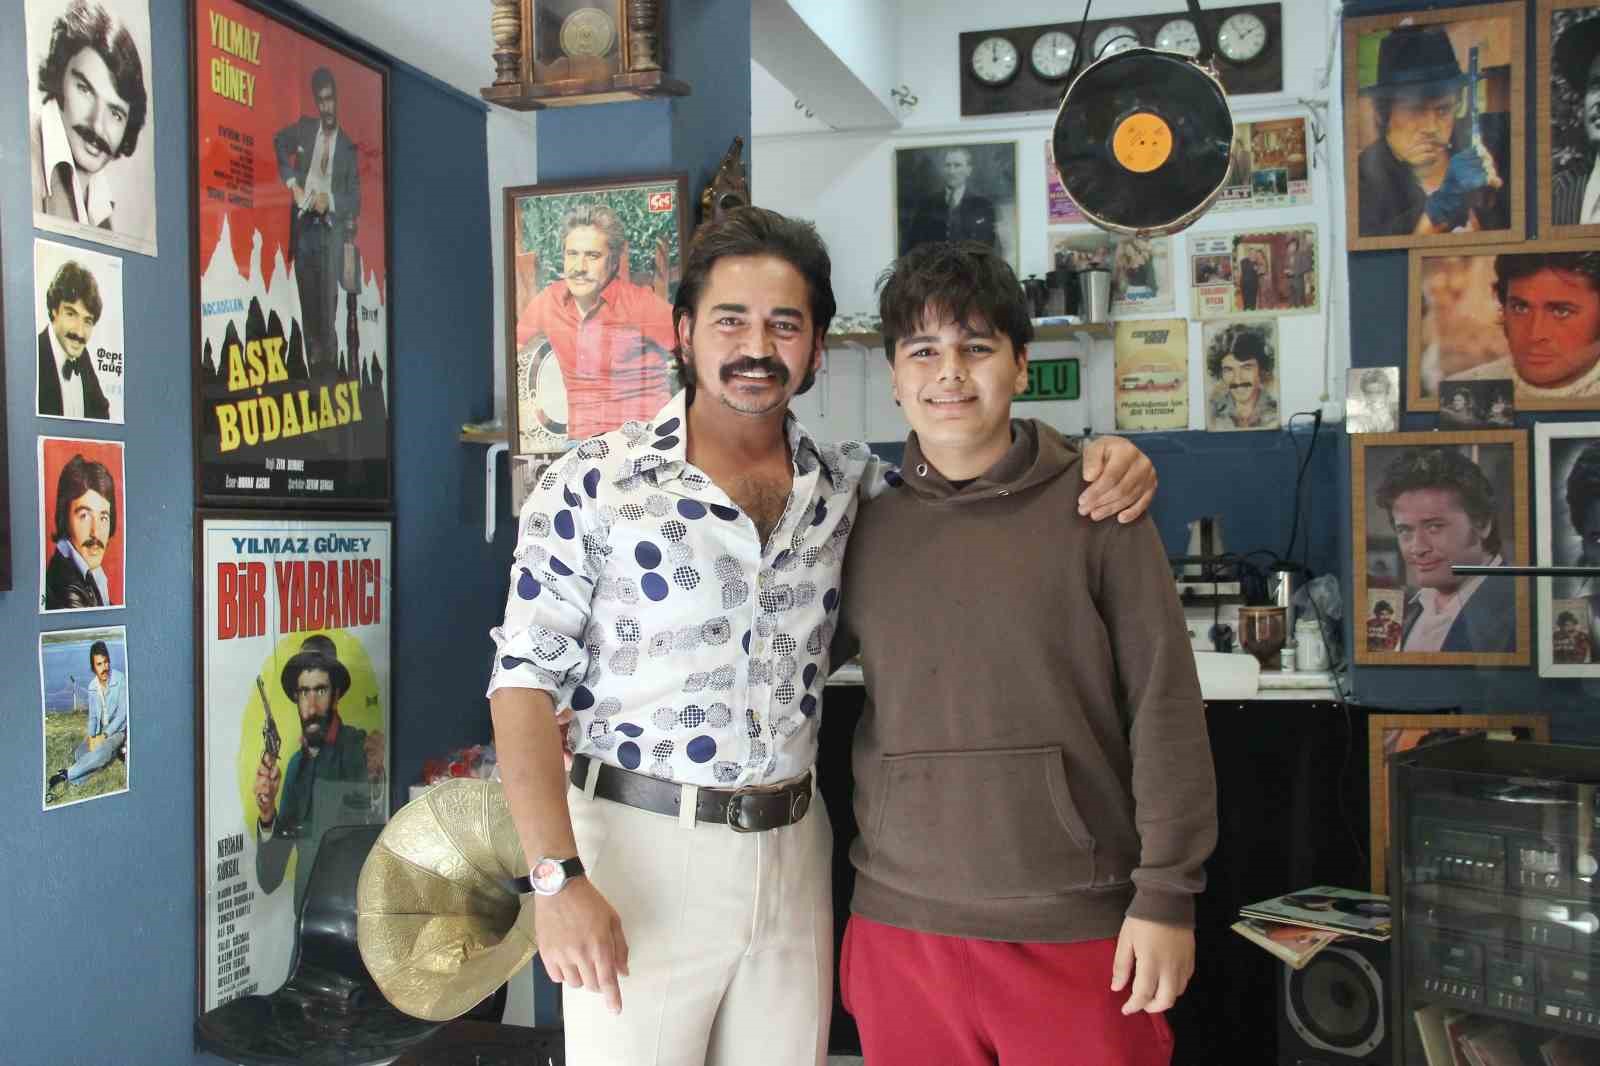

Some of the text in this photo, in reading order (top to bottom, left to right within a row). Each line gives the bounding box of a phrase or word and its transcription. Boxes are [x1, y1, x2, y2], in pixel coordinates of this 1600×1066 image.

[209, 9, 261, 66] YILMAZ
[211, 57, 256, 108] GÜNEY
[215, 380, 363, 452] BUDALASI
[232, 533, 371, 554] YILMAZ GÜNEY
[274, 558, 381, 634] YABANCI
